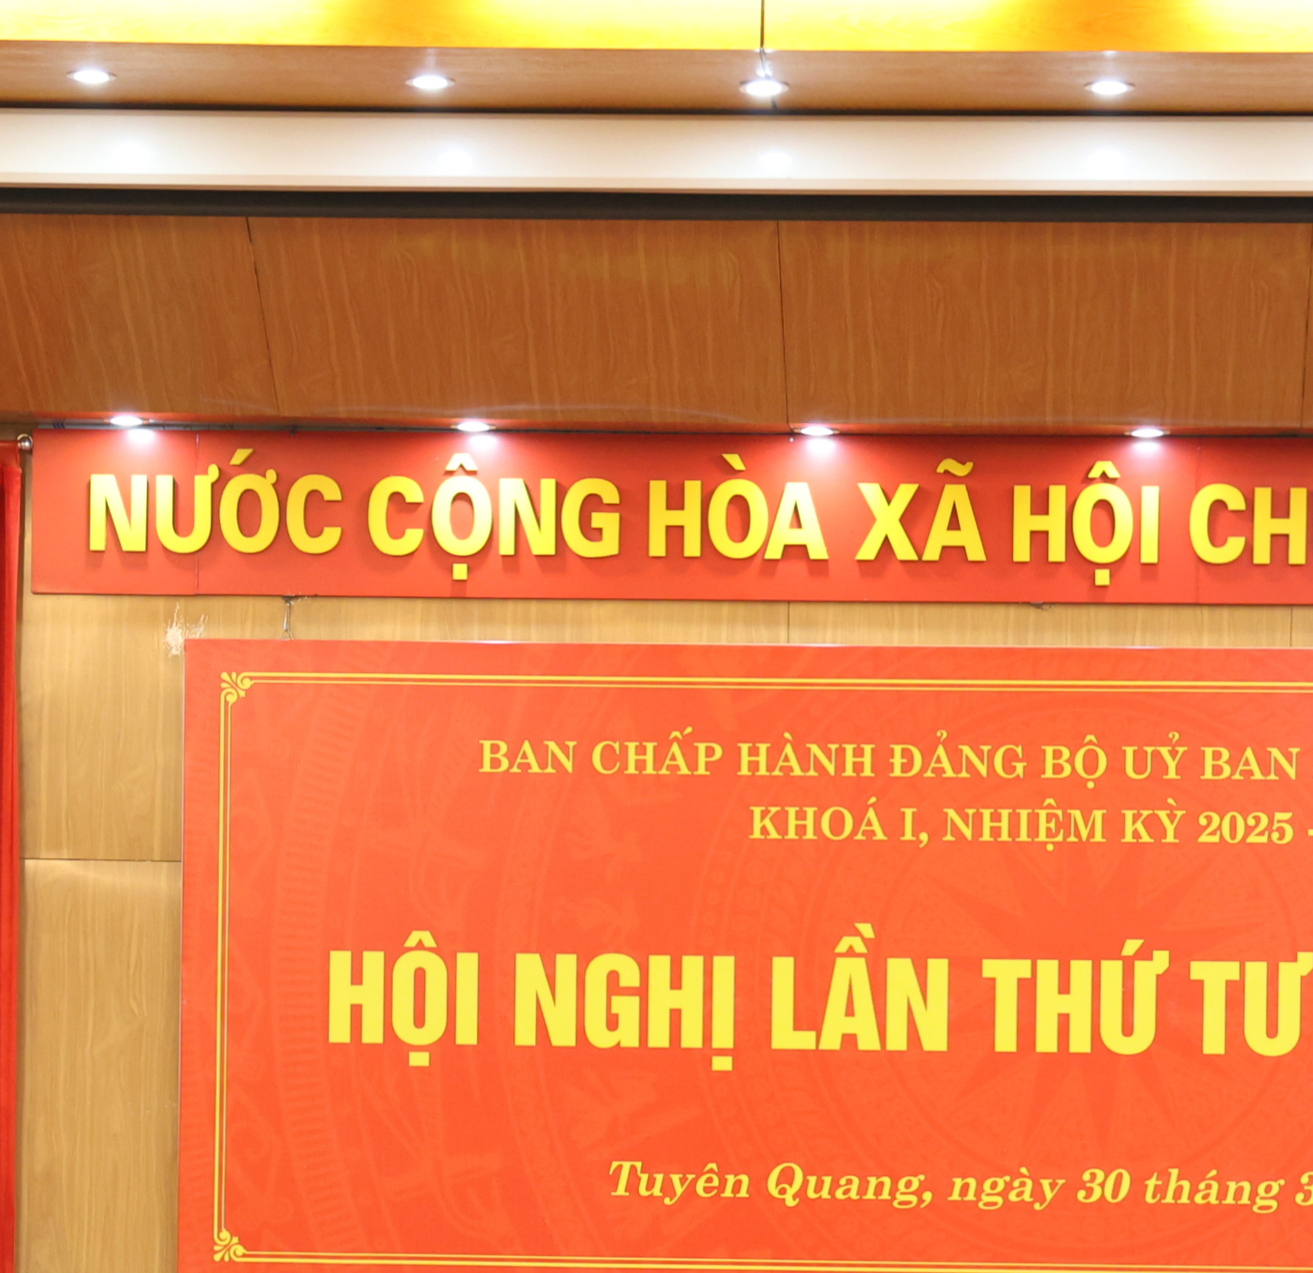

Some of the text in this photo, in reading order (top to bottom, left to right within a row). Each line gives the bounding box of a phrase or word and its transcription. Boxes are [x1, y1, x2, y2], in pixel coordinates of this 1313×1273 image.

[89, 448, 342, 554] NƯỚC
[368, 451, 620, 580] CỘNG
[648, 453, 829, 560] HÒA
[855, 459, 987, 561] XÃ
[1012, 460, 1162, 586] HỘI
[478, 740, 577, 773] BAN
[592, 726, 723, 775] CHẤP
[737, 732, 875, 777] HÀNH
[889, 730, 1027, 779] ĐẢNG
[1040, 734, 1107, 789] BỘ
[1121, 731, 1188, 780] UỶ
[1200, 746, 1301, 780] BAN
[749, 796, 888, 840] KHOÁ
[900, 808, 929, 848] I,
[942, 798, 1107, 851] NHIỆM
[1120, 797, 1186, 843] KỲ
[1197, 811, 1294, 845] 2025
[328, 930, 479, 1067] HỘI
[514, 952, 736, 1071] NGHỊ
[771, 922, 949, 1052] LẦN
[981, 938, 1170, 1055] THỨ
[609, 1161, 750, 1206] Tuyên
[767, 1162, 933, 1209] Quang,
[947, 1166, 1066, 1211] ngày
[1076, 1168, 1131, 1203] 30
[1144, 1168, 1286, 1214] tháng
